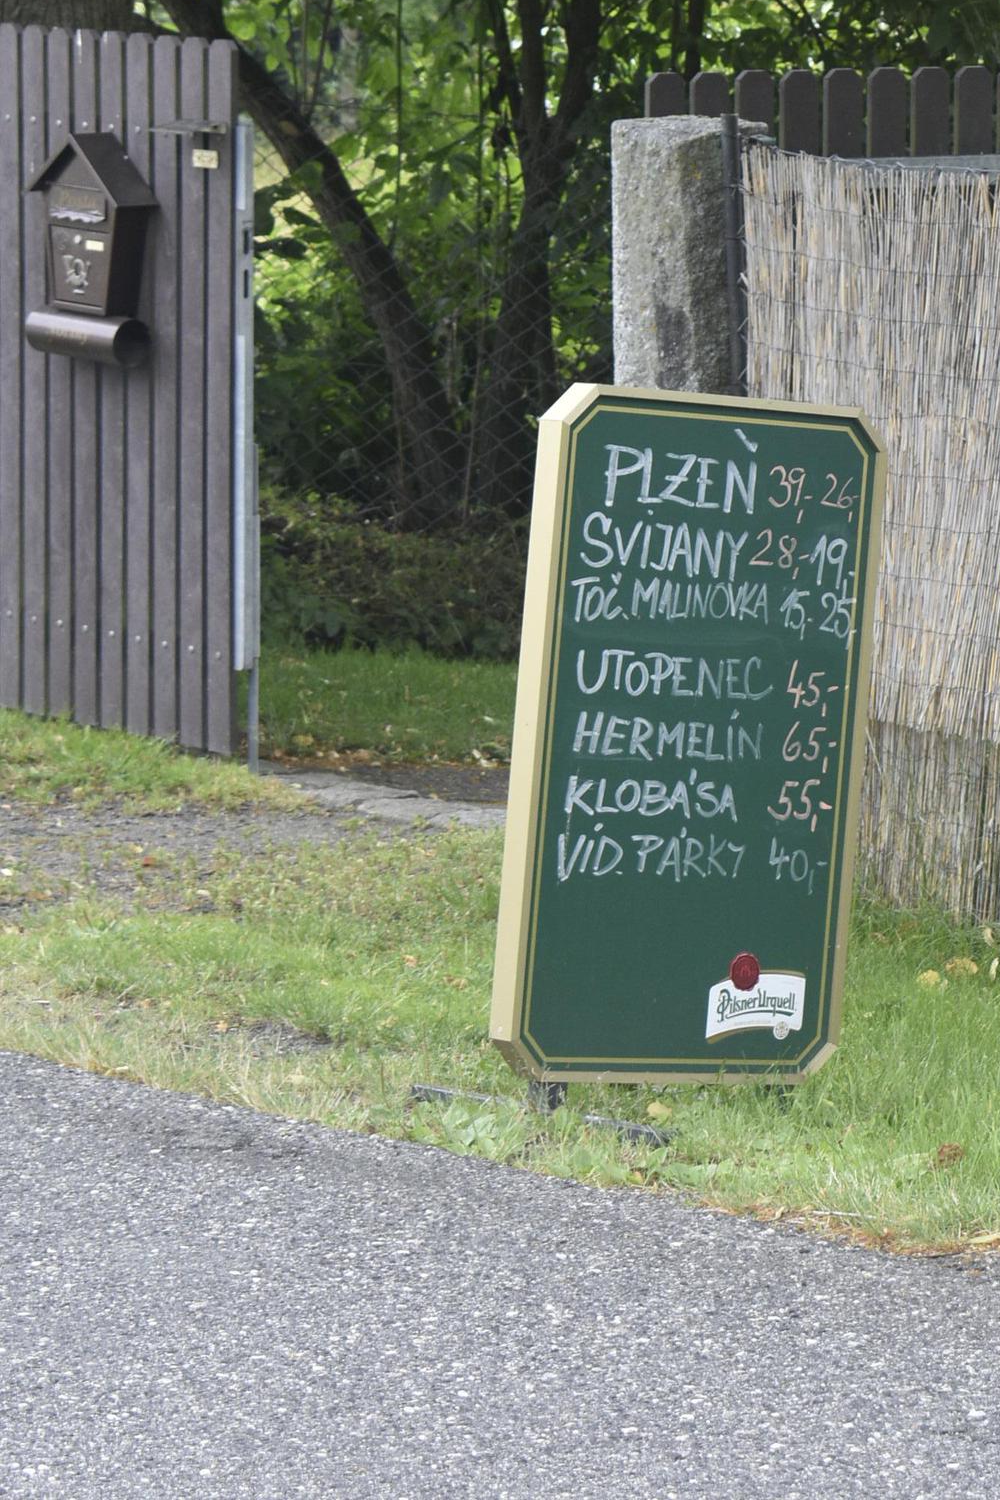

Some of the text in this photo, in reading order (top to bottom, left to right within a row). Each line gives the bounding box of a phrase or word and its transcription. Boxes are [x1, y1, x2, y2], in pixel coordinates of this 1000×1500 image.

[603, 428, 759, 514] PLZEŇ
[580, 509, 749, 582] SVIJANY
[632, 576, 768, 625] MALINOVKA
[576, 649, 773, 700] UTOPENEC
[572, 708, 763, 763] HERMELÍN
[564, 768, 738, 823] KLOBÁSA
[717, 988, 796, 1023] Pilsner Urquell
